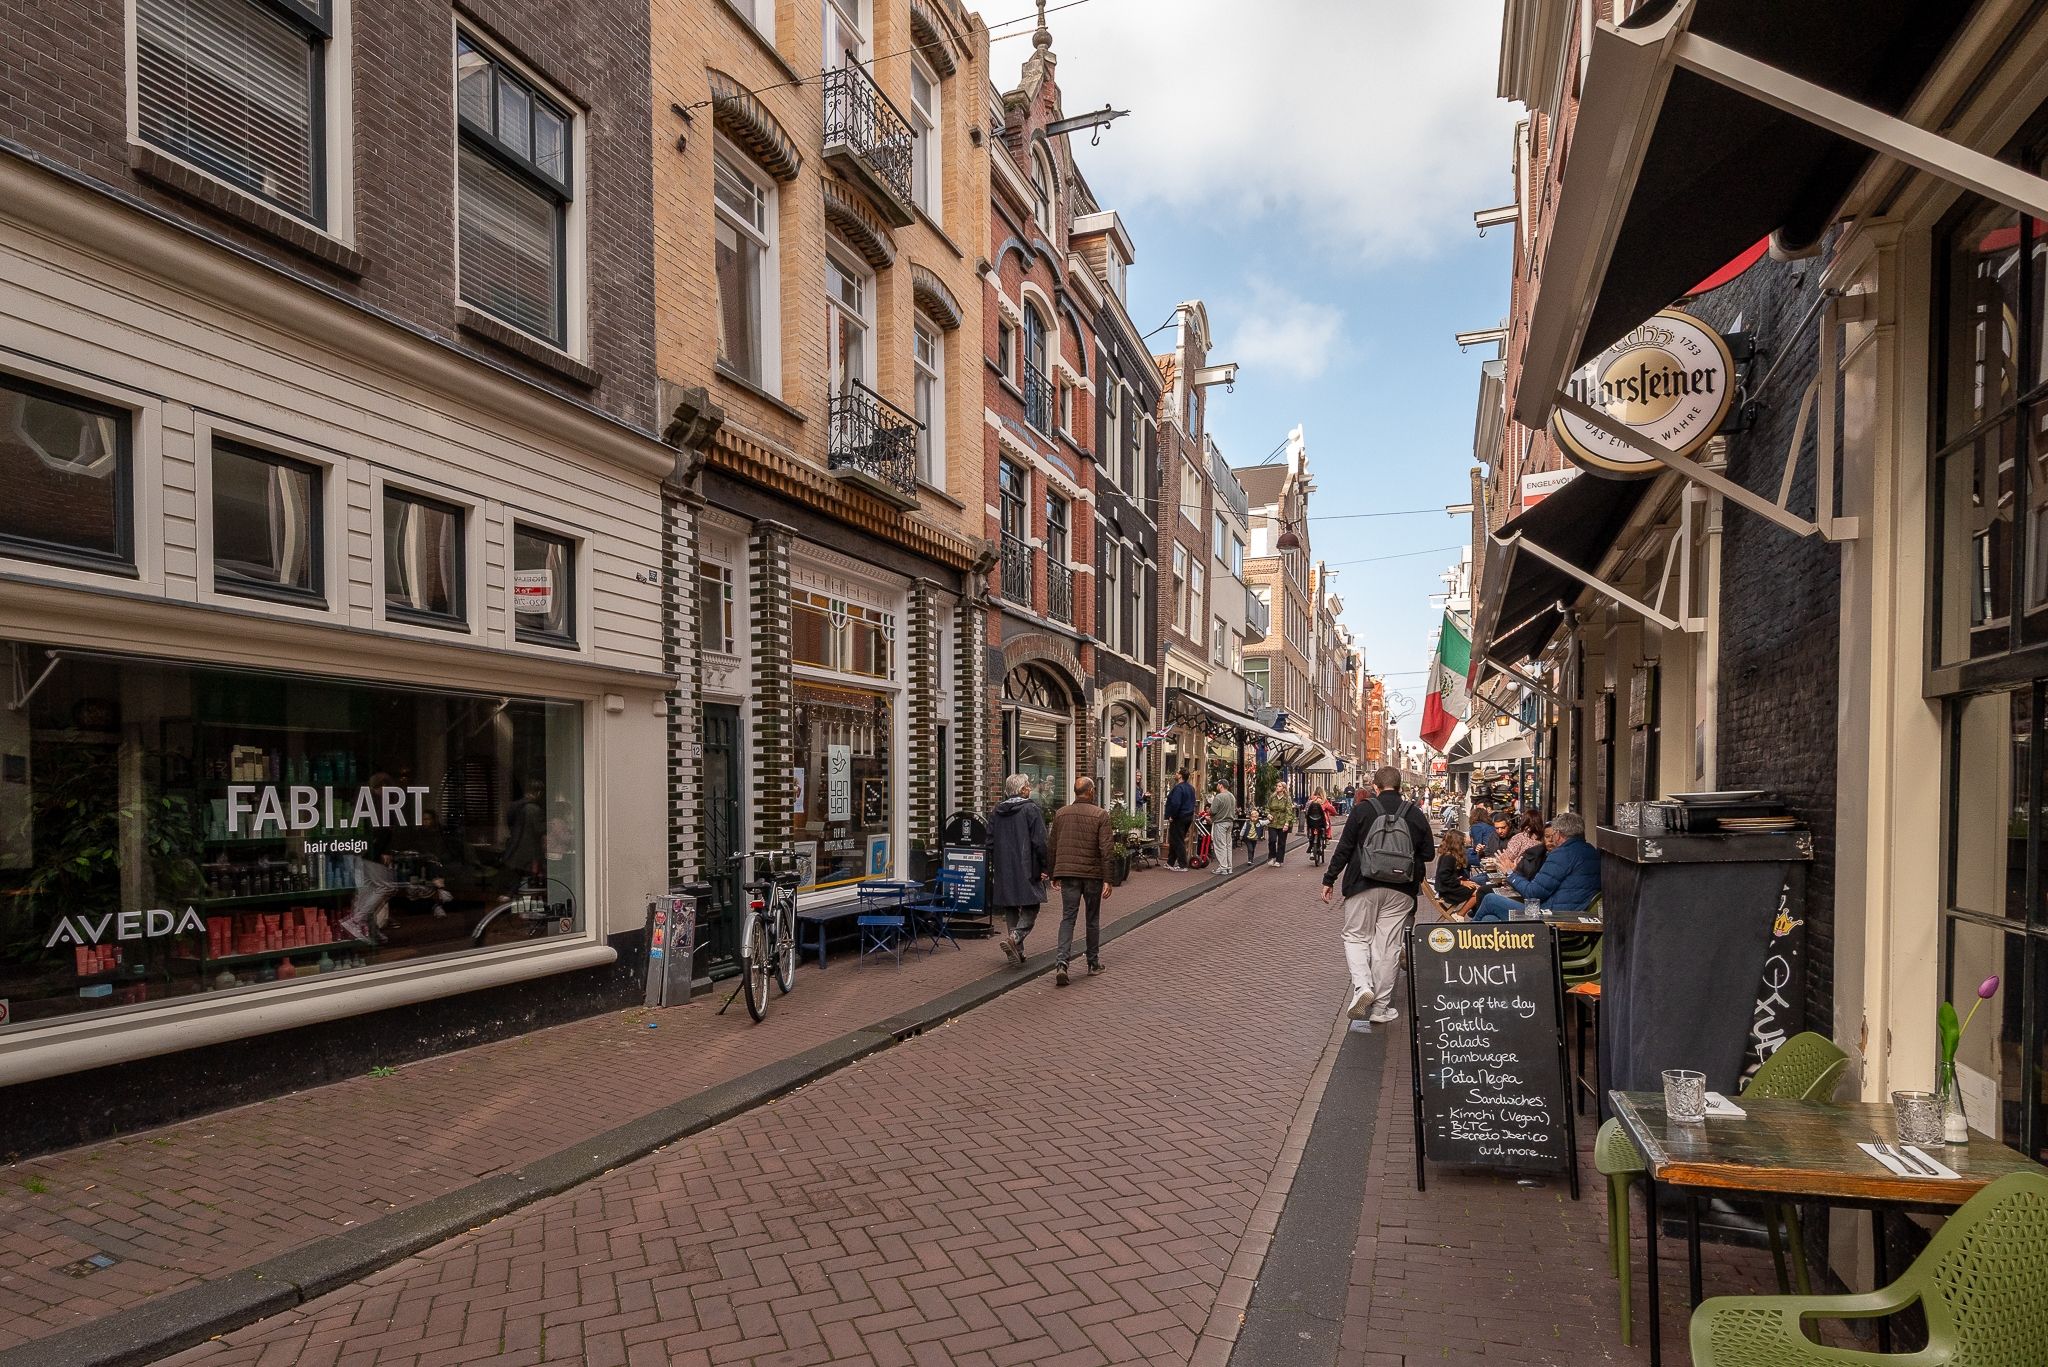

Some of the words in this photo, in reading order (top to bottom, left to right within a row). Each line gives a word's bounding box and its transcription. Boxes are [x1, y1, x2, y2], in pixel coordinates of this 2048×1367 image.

[1680, 336, 1702, 356] 1753
[1570, 362, 1717, 407] Warsteiner
[1585, 422, 1604, 440] DAS
[1661, 406, 1702, 441] WAHRE
[693, 746, 700, 756] 12
[227, 785, 430, 832] FABI.ART
[304, 841, 327, 853] hair
[330, 839, 368, 853] design
[46, 905, 206, 948] AVEDA
[1457, 927, 1535, 952] Warsteiner
[1444, 961, 1517, 985] LUNCH
[1434, 995, 1470, 1015] Soup
[1473, 997, 1485, 1013] of
[1488, 996, 1508, 1009] the
[1512, 996, 1535, 1018] day
[1435, 1017, 1499, 1032] Tortilla
[1437, 1033, 1490, 1049] Salads
[1441, 1050, 1519, 1068] Hamburger
[1441, 1067, 1478, 1089] Pata
[1449, 1107, 1495, 1121] Kimchi
[1500, 1108, 1550, 1128] (Vegan)
[1451, 1121, 1493, 1131] BLTC
[1451, 1130, 1500, 1140] Secreto
[1478, 1144, 1505, 1156] and
